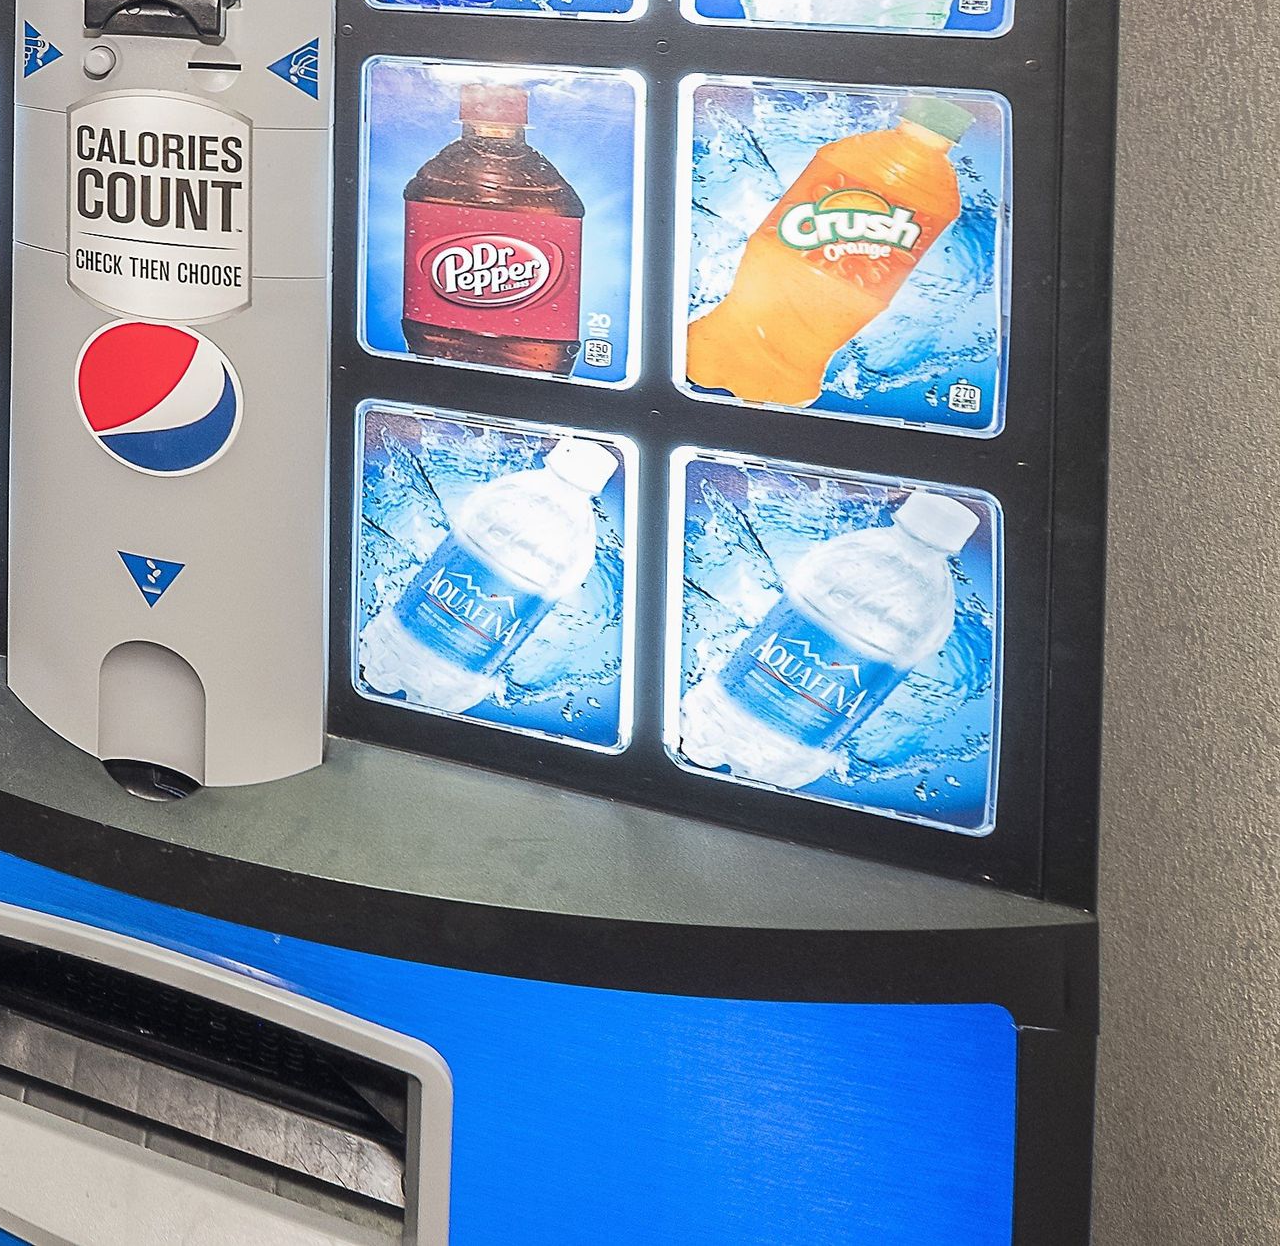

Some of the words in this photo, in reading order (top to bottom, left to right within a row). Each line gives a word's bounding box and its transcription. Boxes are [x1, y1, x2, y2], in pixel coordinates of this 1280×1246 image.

[75, 124, 243, 174] CALORIES
[75, 167, 243, 233] COUNT
[780, 202, 920, 251] Crush
[75, 247, 123, 276] CHECK
[129, 255, 171, 283] THEN
[176, 260, 243, 288] CHOOSE
[432, 246, 541, 296] Pepper
[471, 242, 516, 272] Dr
[823, 242, 892, 262] Orange
[587, 312, 611, 329] 20
[589, 342, 608, 353] 250
[955, 386, 976, 399] 270
[421, 566, 523, 646] AQUAFINA
[749, 632, 869, 720] AQUAFINA
